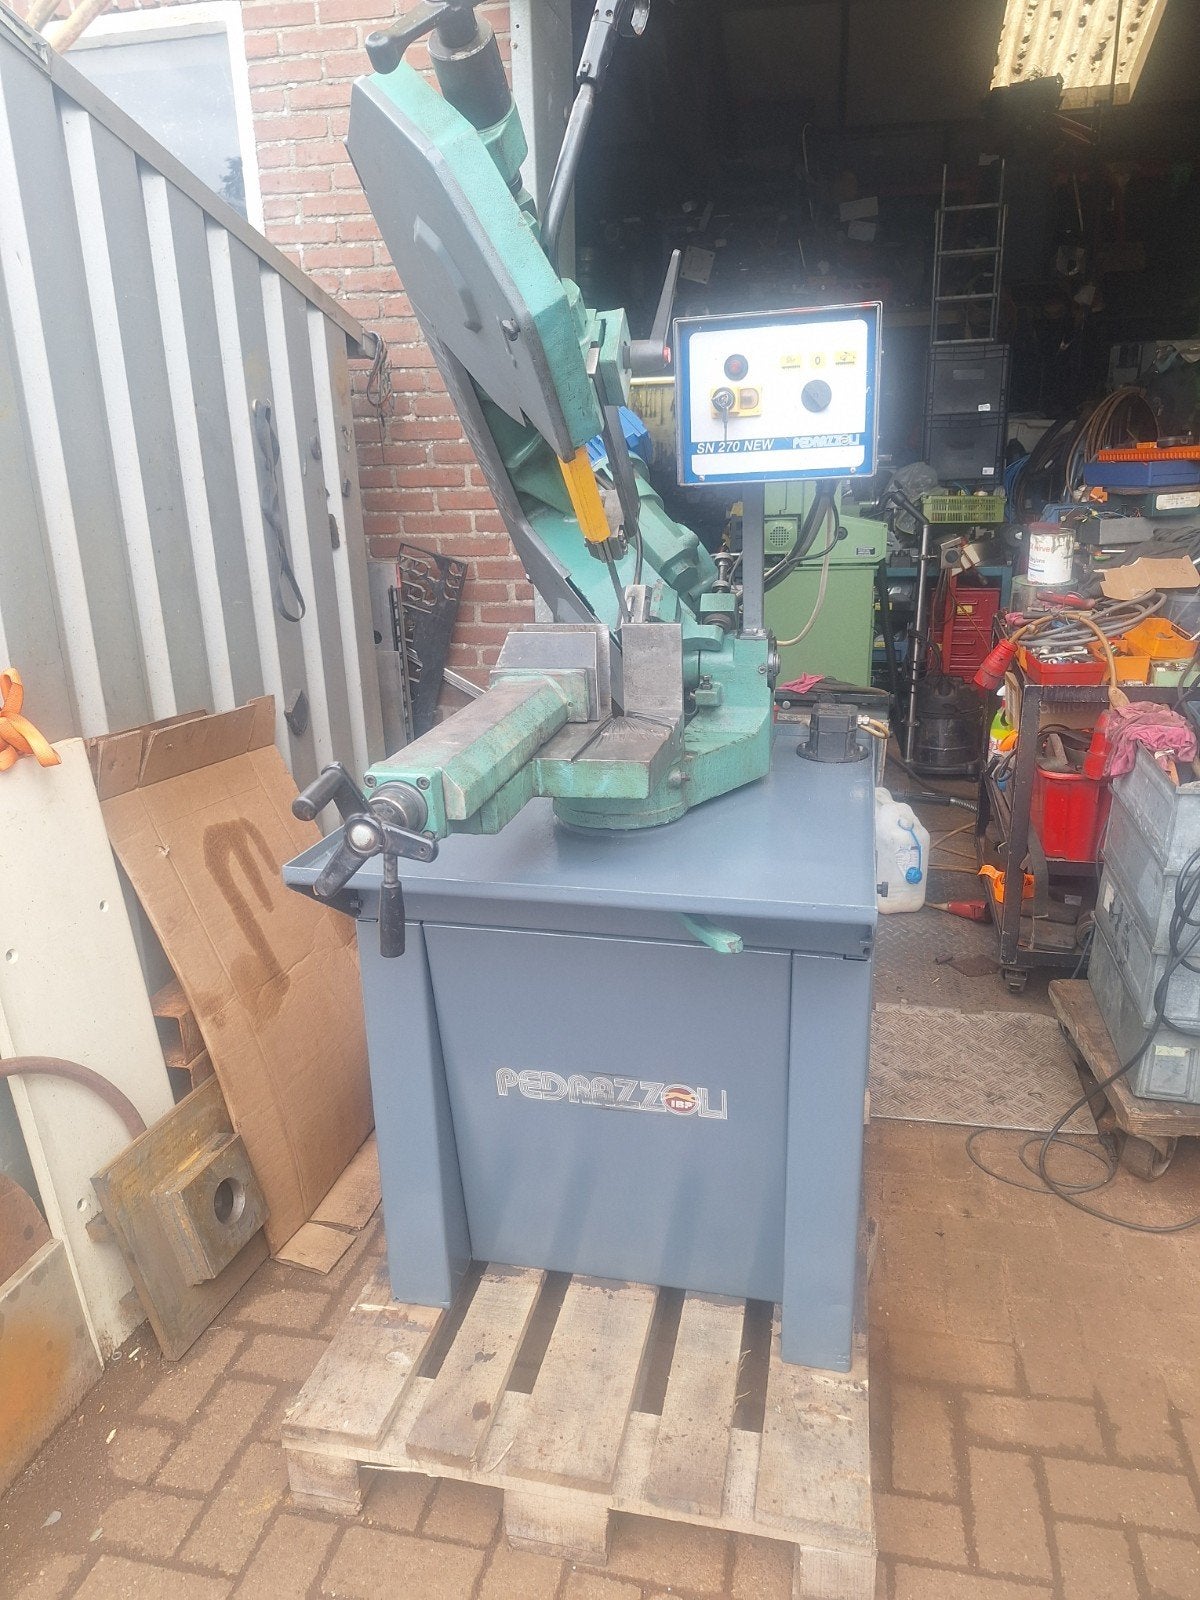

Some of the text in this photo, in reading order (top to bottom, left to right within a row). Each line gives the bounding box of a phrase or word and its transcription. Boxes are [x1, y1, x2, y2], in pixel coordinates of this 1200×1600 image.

[696, 438, 775, 454] SN 270 NEW
[495, 1067, 728, 1120] PEDRAZZOLI
[670, 1099, 694, 1109] IBP
